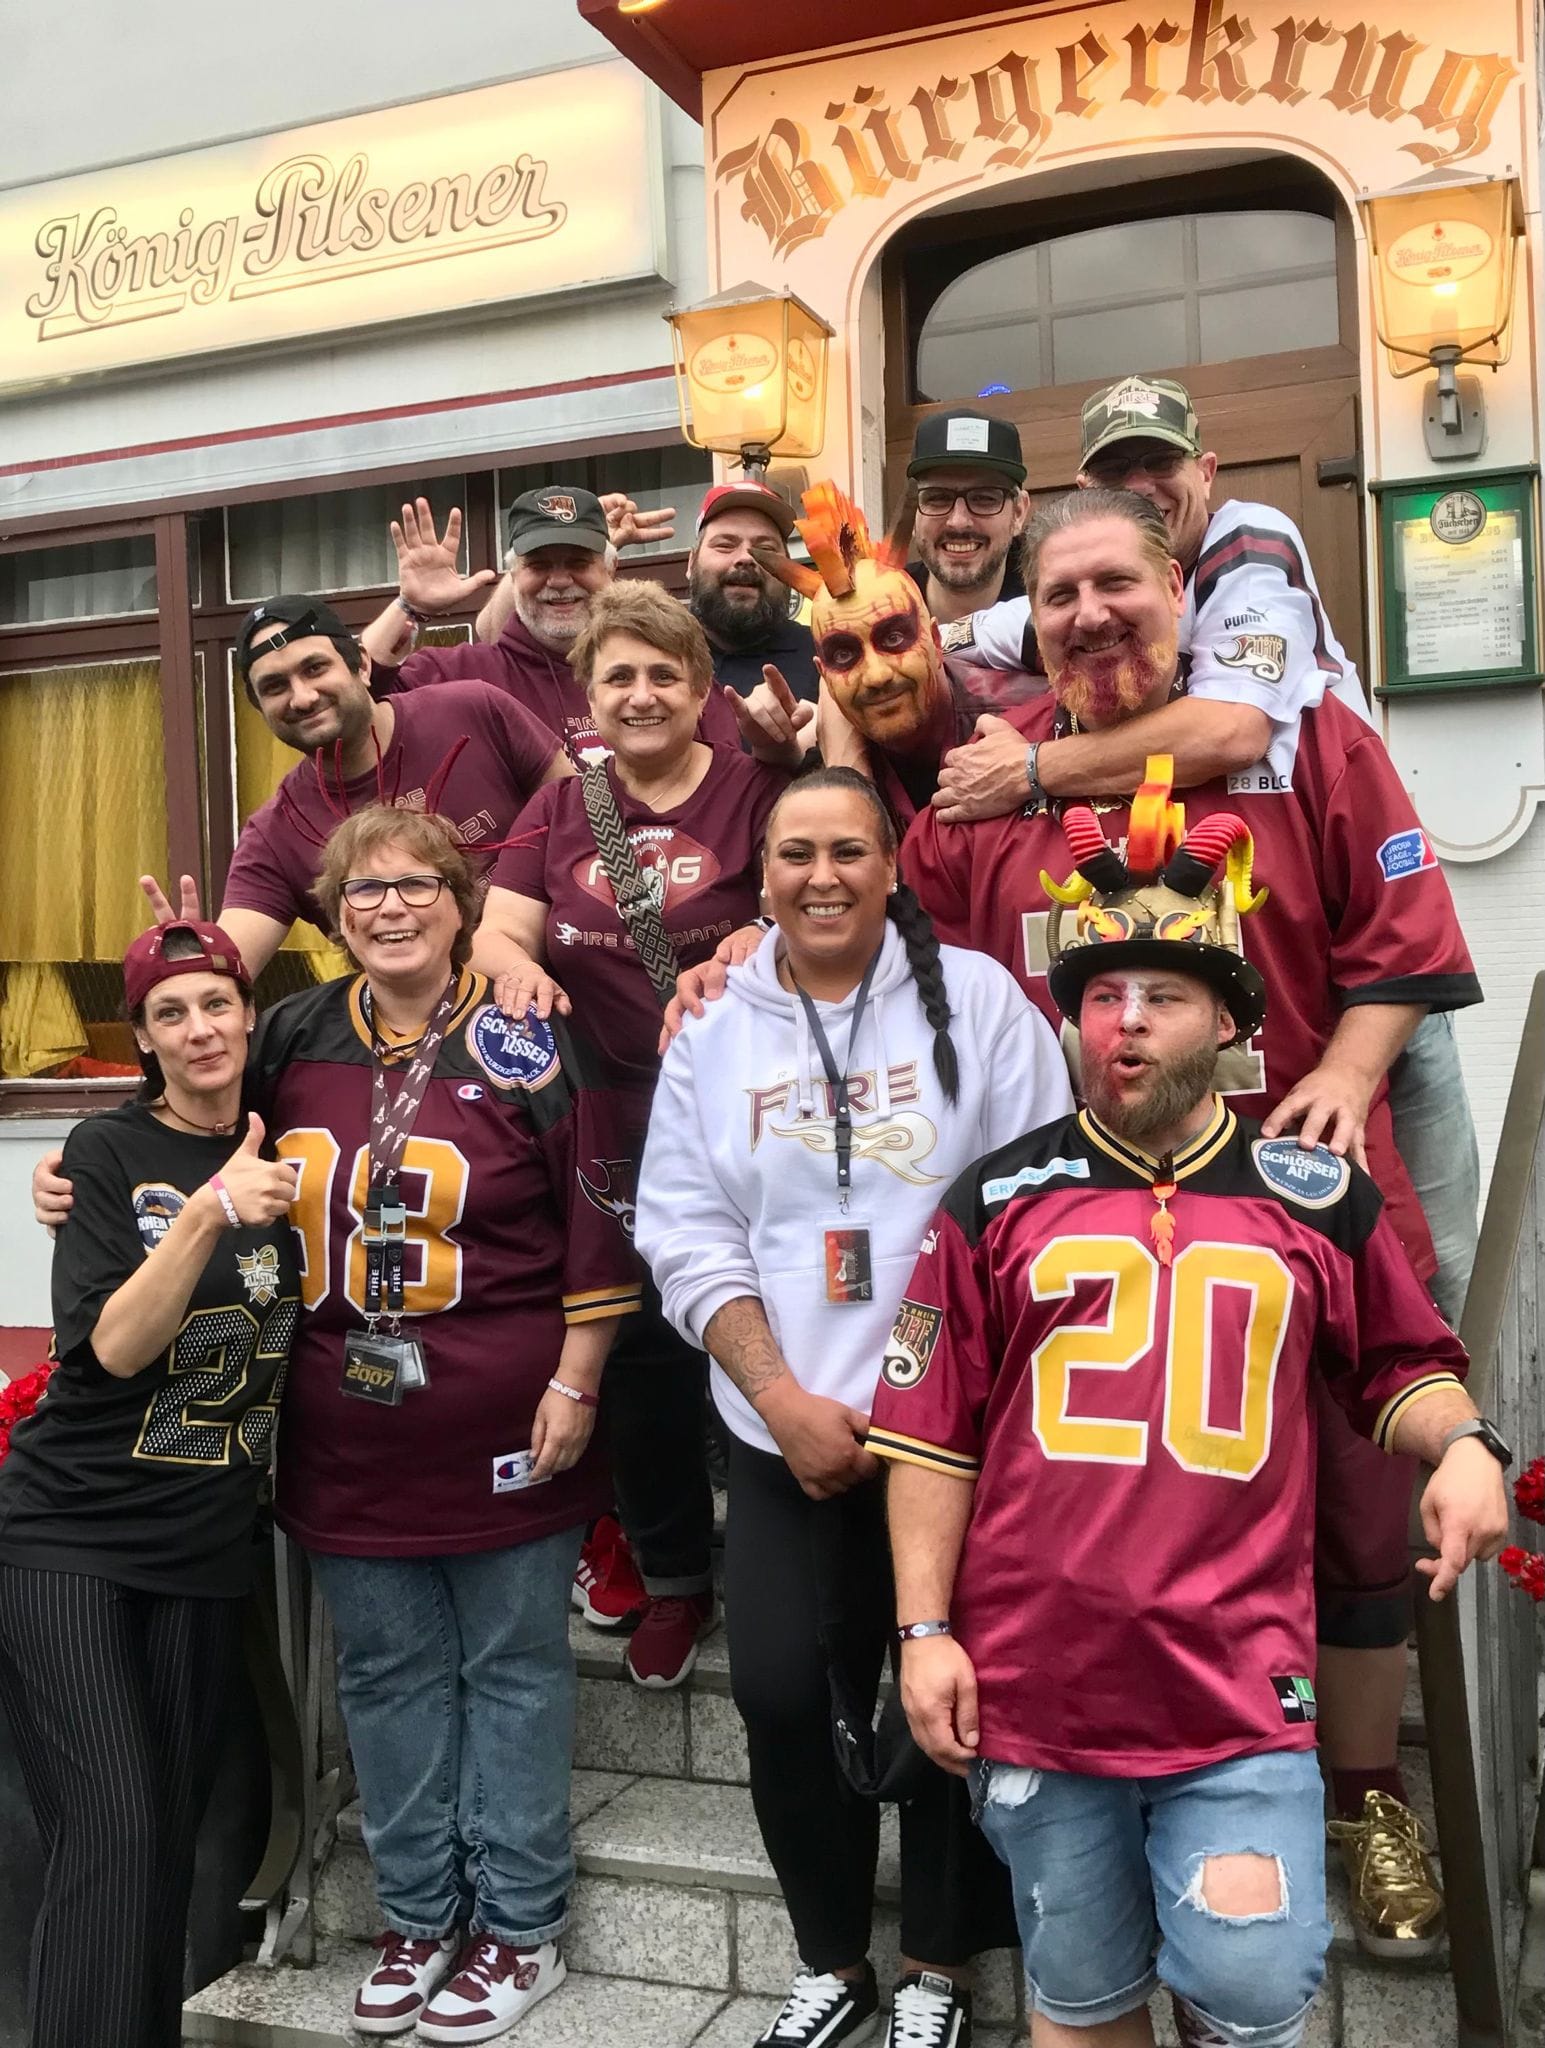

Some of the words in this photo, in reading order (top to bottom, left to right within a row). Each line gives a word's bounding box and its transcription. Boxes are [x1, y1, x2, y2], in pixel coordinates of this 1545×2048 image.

[714, 0, 1522, 262] Bürgerkrug
[25, 152, 568, 324] König-Pilsener
[1230, 777, 1251, 790] 28
[458, 809, 497, 844] 21
[1260, 1150, 1340, 1180] SCHLÖSSER
[1286, 1166, 1312, 1181] ALT
[371, 1268, 380, 1297] FIRE
[392, 1265, 401, 1293] FIRE
[1029, 1234, 1295, 1482] 20
[345, 1363, 395, 1388] 2007
